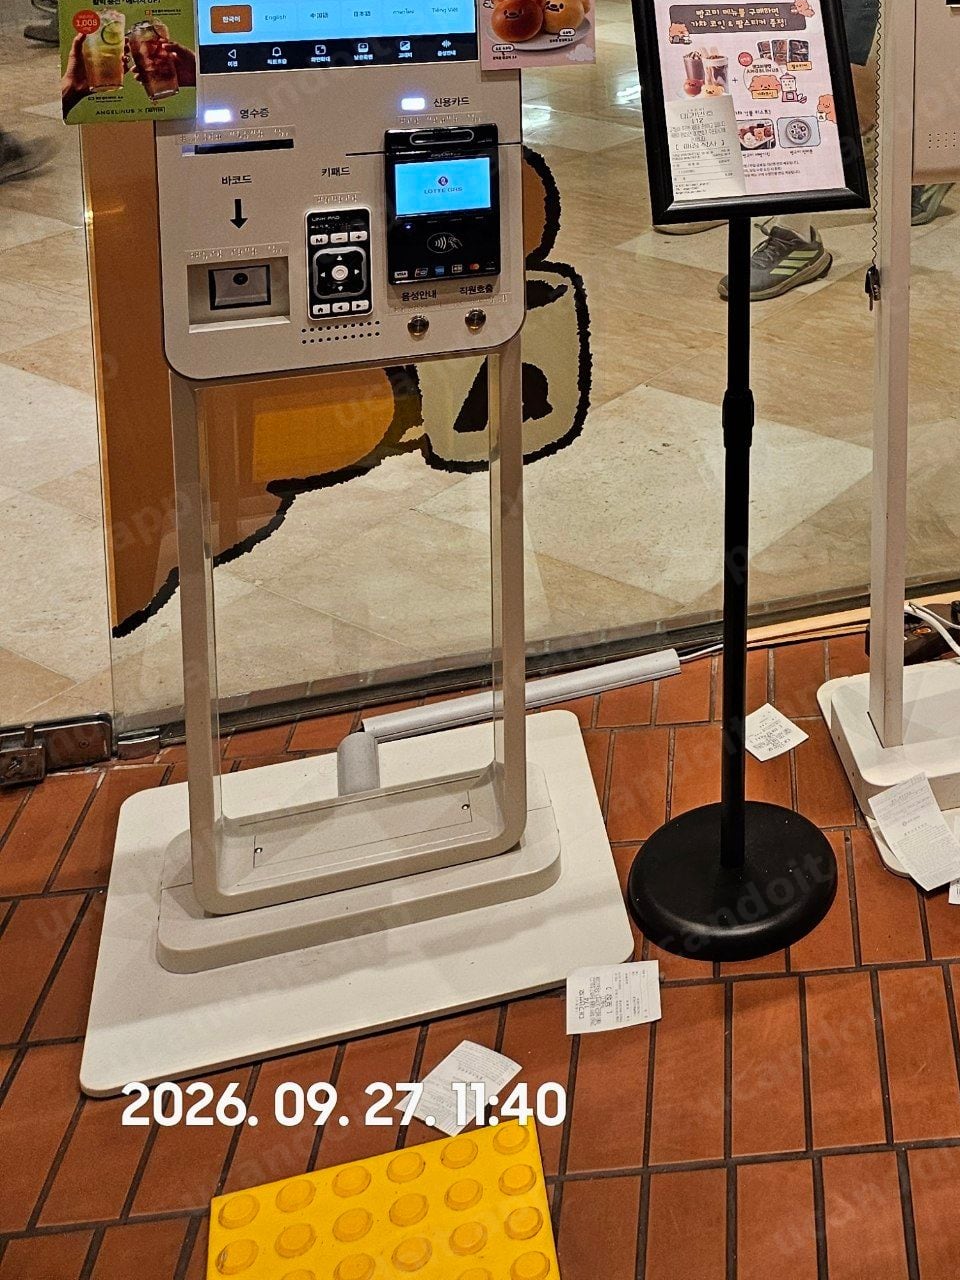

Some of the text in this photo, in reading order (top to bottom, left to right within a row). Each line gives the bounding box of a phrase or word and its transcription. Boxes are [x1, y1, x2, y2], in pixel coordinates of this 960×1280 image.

[433, 97, 469, 107] 신용카드
[240, 108, 269, 118] 영수증
[321, 167, 350, 177] 키패드
[222, 175, 252, 185] 바코드
[459, 284, 493, 295] 직원호출
[402, 290, 437, 301] 음성안내
